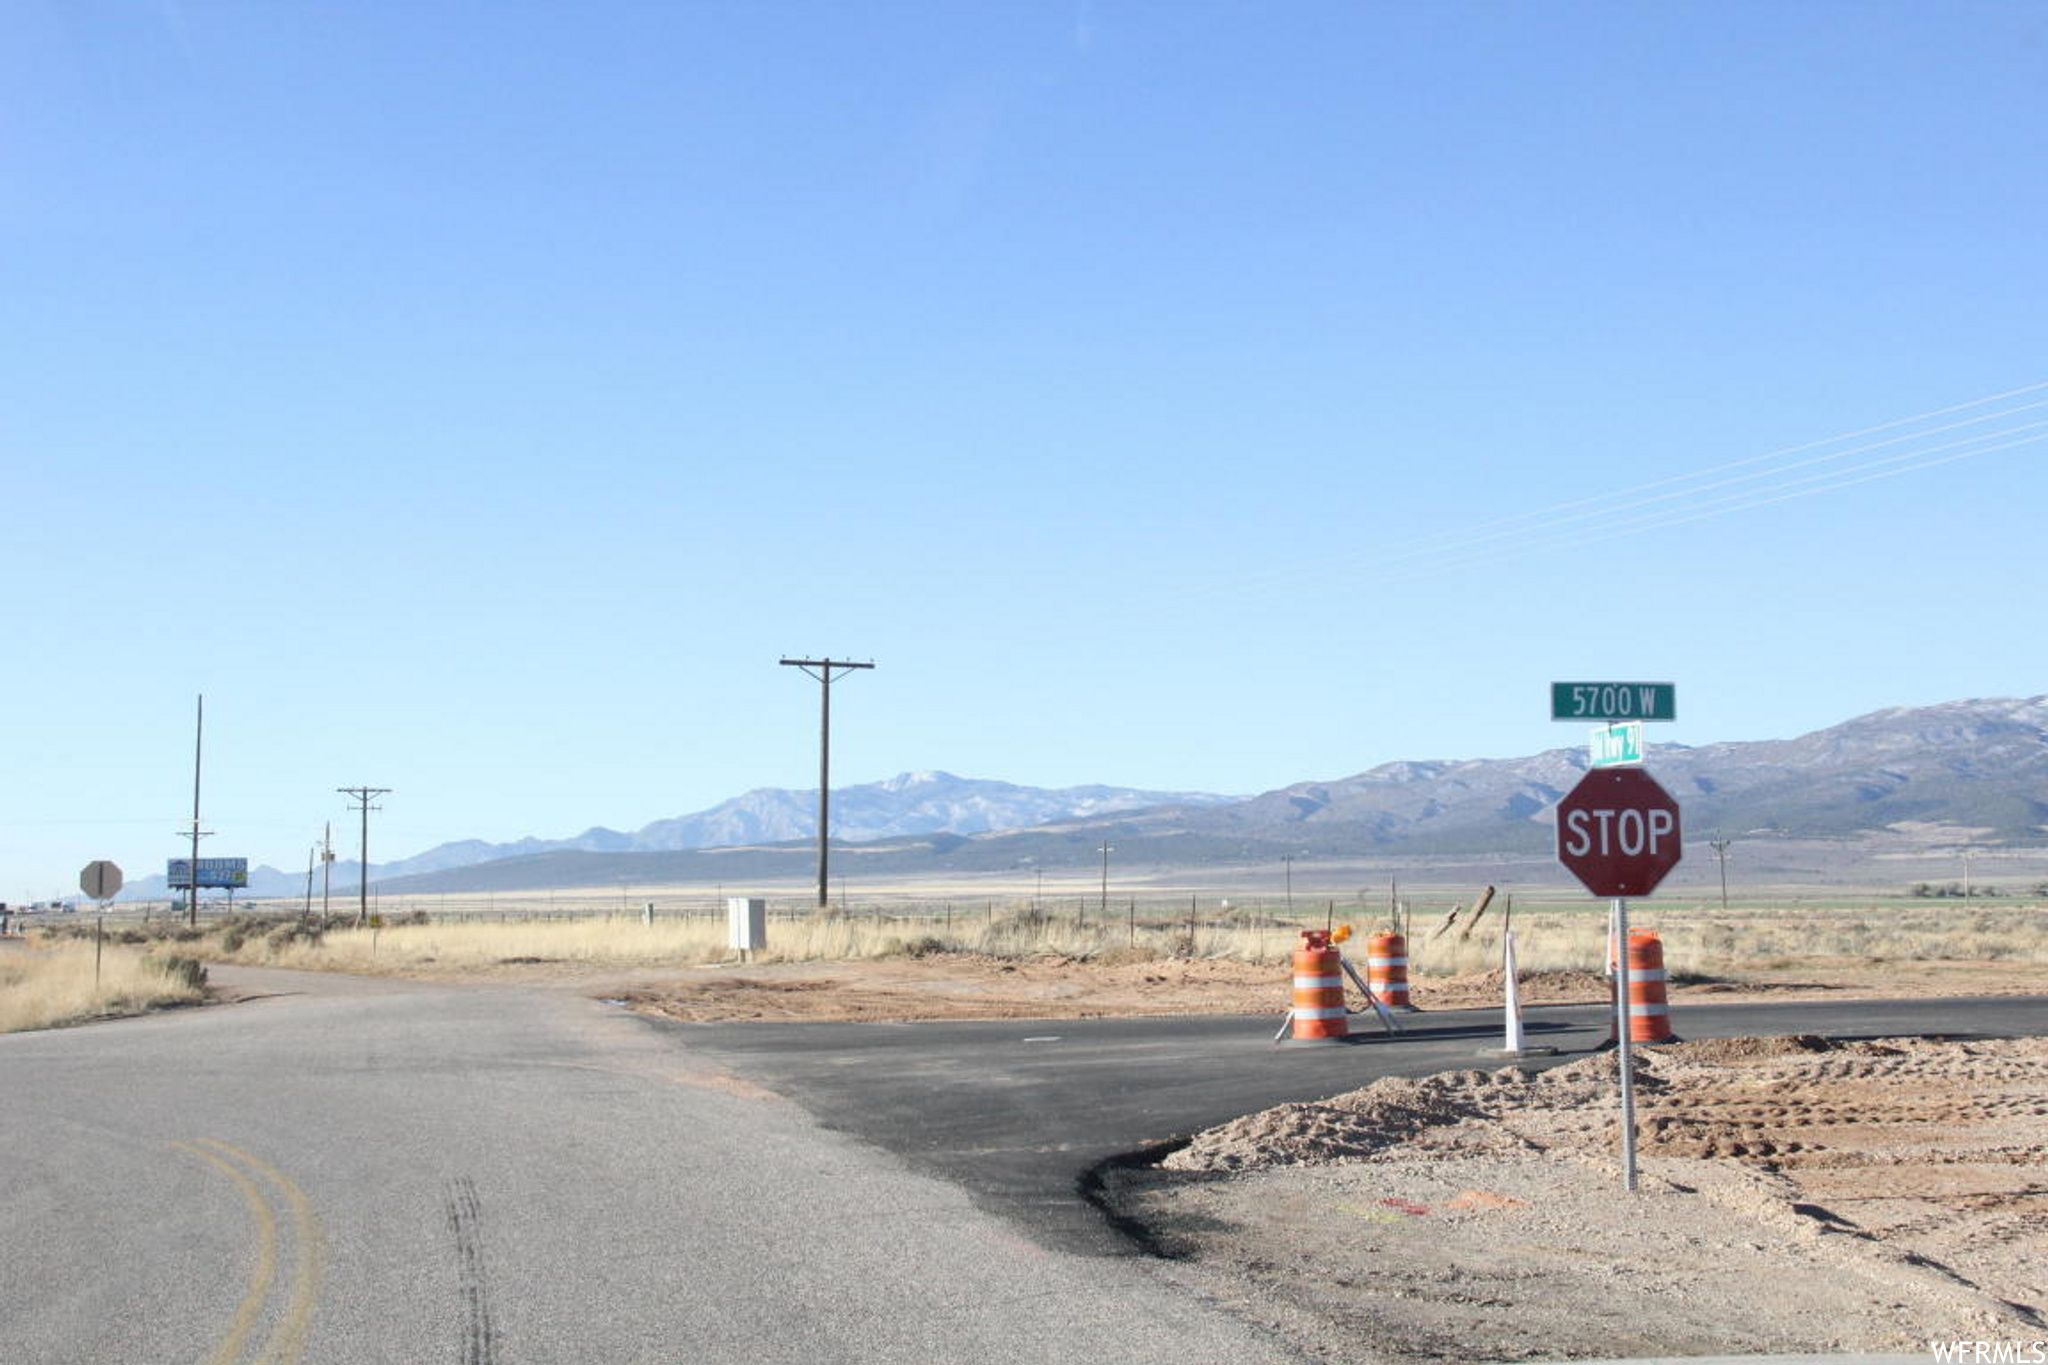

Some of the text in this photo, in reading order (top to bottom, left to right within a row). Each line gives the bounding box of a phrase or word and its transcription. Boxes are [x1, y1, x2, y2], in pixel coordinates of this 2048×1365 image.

[1573, 686, 1656, 716] 5700 W
[1566, 808, 1674, 857] STOP
